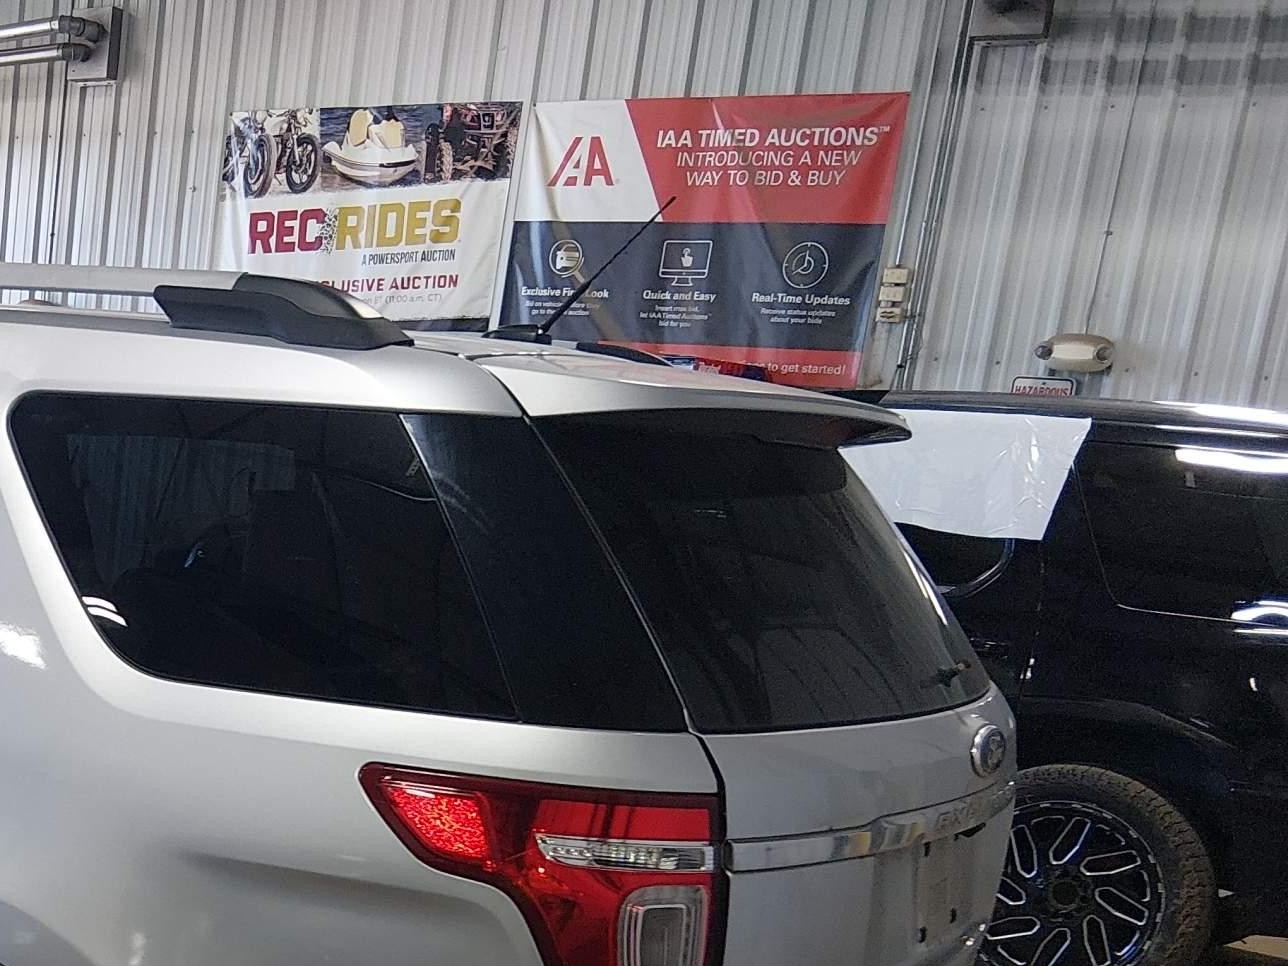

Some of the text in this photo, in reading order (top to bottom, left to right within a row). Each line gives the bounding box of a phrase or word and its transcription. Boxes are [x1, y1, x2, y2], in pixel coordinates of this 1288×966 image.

[657, 130, 692, 147] IAA
[698, 128, 760, 147] TIMED
[677, 150, 862, 167] INTRODUCING A NEW
[686, 170, 846, 187] WAY TO BID & BUY
[249, 198, 463, 255] REC RIDES
[361, 249, 456, 266] A POWERSPORT AUCTION
[389, 274, 459, 290] AUCTION
[521, 286, 561, 297] Exclusive
[585, 289, 609, 298] Look
[643, 290, 716, 302] Quick and Easy
[752, 292, 851, 306] Real-Time Updates
[768, 360, 778, 372] to
[781, 362, 800, 375] get
[801, 363, 846, 376] started!
